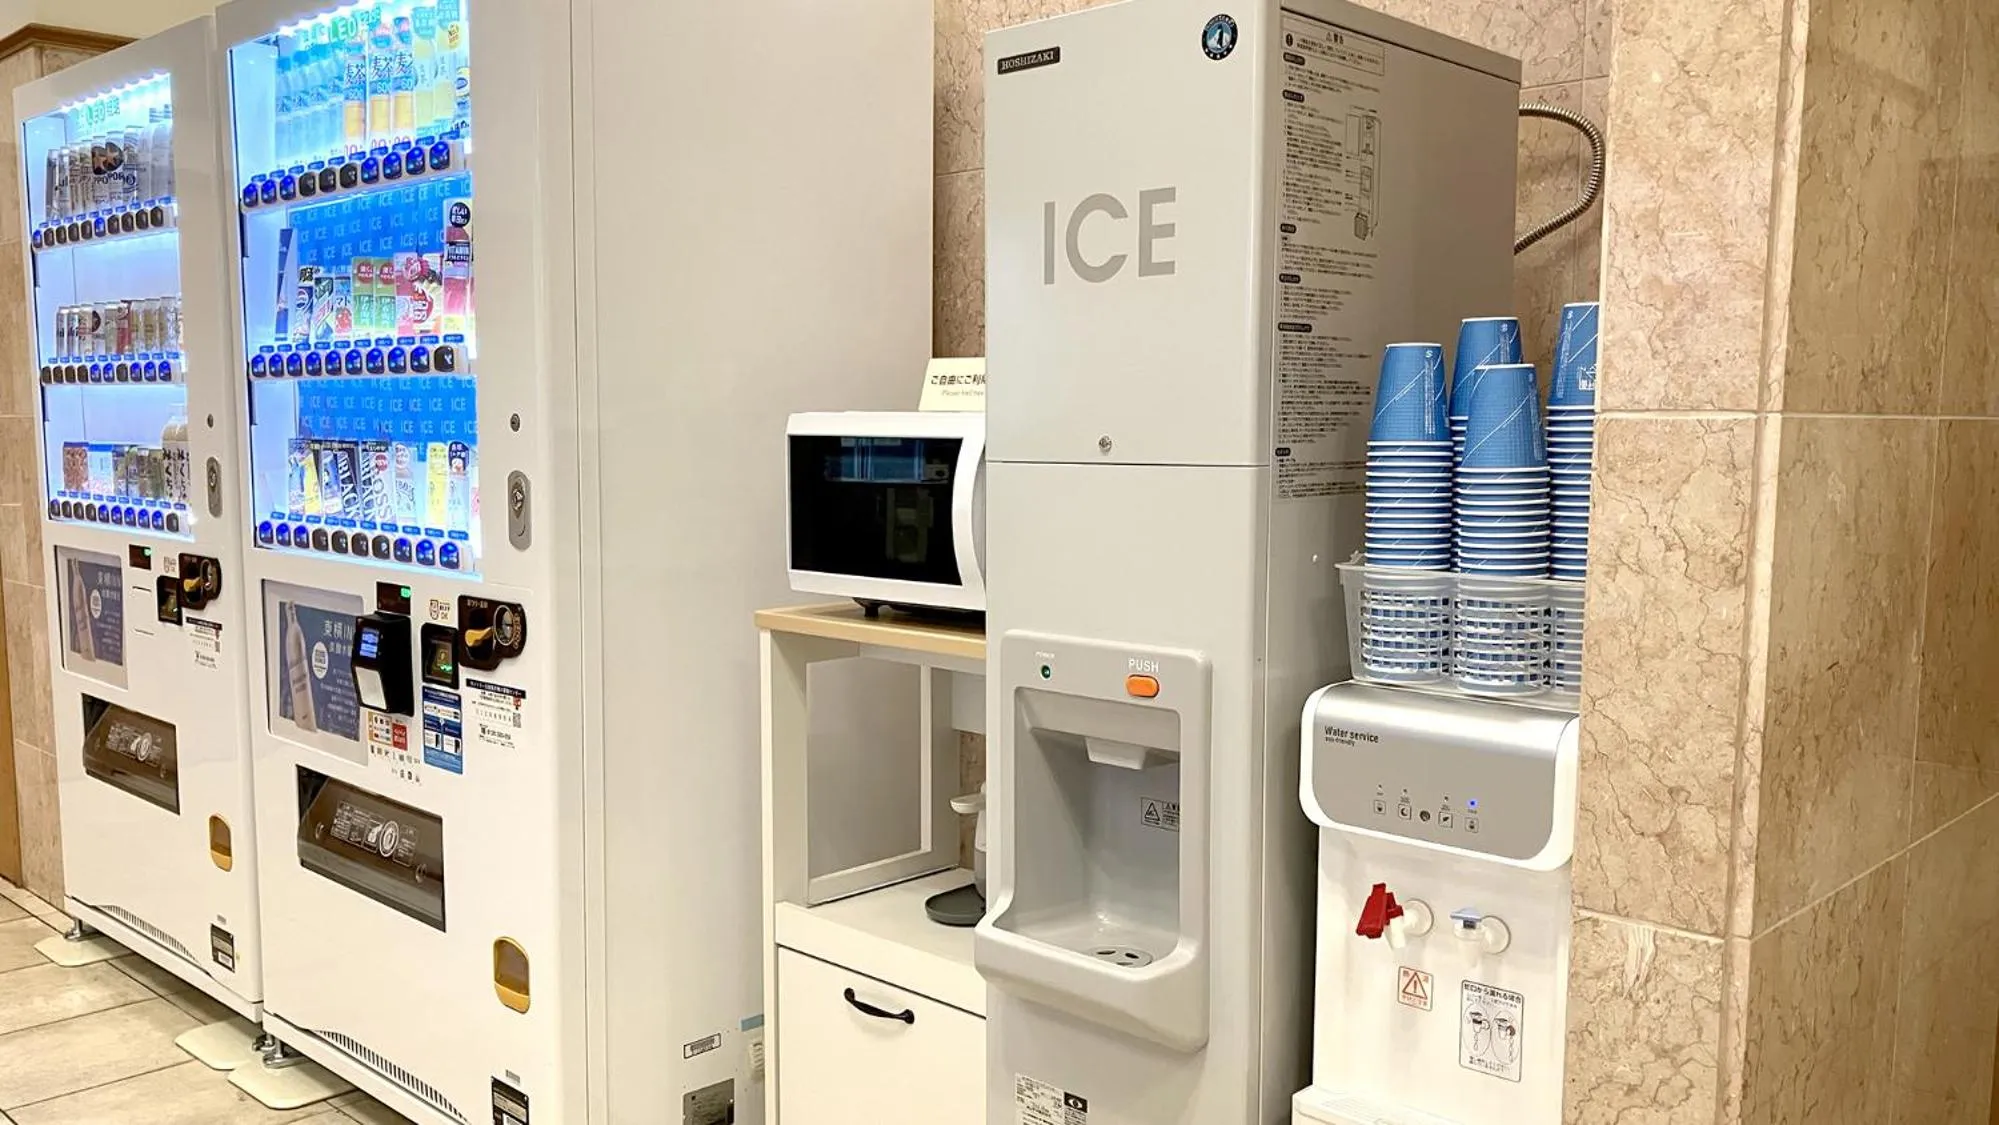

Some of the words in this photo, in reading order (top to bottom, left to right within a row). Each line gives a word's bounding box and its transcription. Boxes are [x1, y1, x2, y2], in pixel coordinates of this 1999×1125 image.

[1001, 50, 1054, 70] HOSHIZAKI
[378, 192, 392, 207] ICE
[401, 186, 416, 203] ICE
[435, 182, 450, 197] ICE
[380, 235, 393, 252] ICE
[401, 232, 414, 248] ICE
[1043, 186, 1177, 286] ICE
[1425, 350, 1433, 358] S
[389, 398, 404, 412] ICE
[429, 398, 442, 412] ICE
[451, 396, 466, 412] ICE
[401, 420, 413, 434] ICE
[420, 420, 434, 434] ICE
[440, 420, 455, 434] ICE
[337, 459, 360, 520] BLACK
[1129, 658, 1159, 673] PUSH
[1325, 726, 1348, 737] Water
[1350, 732, 1378, 743] service
